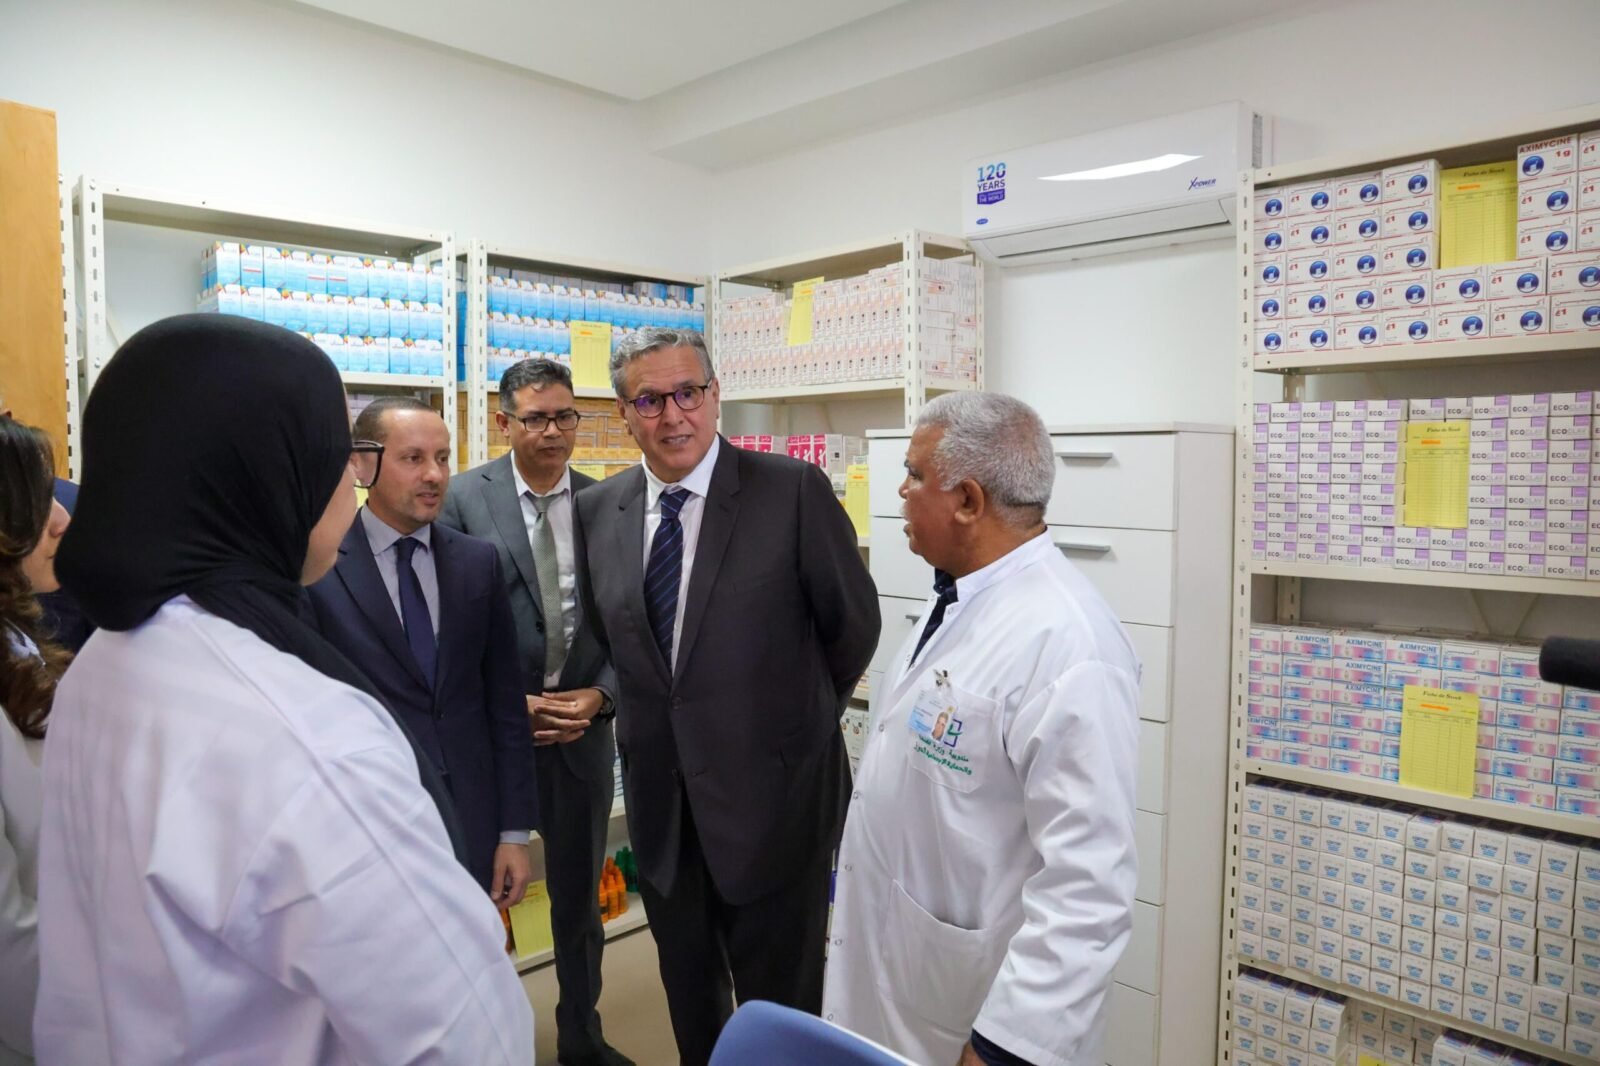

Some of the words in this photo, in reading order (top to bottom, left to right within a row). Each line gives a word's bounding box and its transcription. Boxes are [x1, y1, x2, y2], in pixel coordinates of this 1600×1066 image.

[1519, 136, 1572, 154] AXIMYCINE
[977, 162, 1006, 182] 120
[977, 179, 1005, 192] YEARS
[1295, 635, 1330, 644] AXIMYCINE
[1346, 639, 1382, 648] AXIMYCINE
[1400, 643, 1437, 653] AXIMYCINE
[1346, 662, 1382, 672] AXIMYCINE
[1345, 684, 1381, 694] AXIMYCINE
